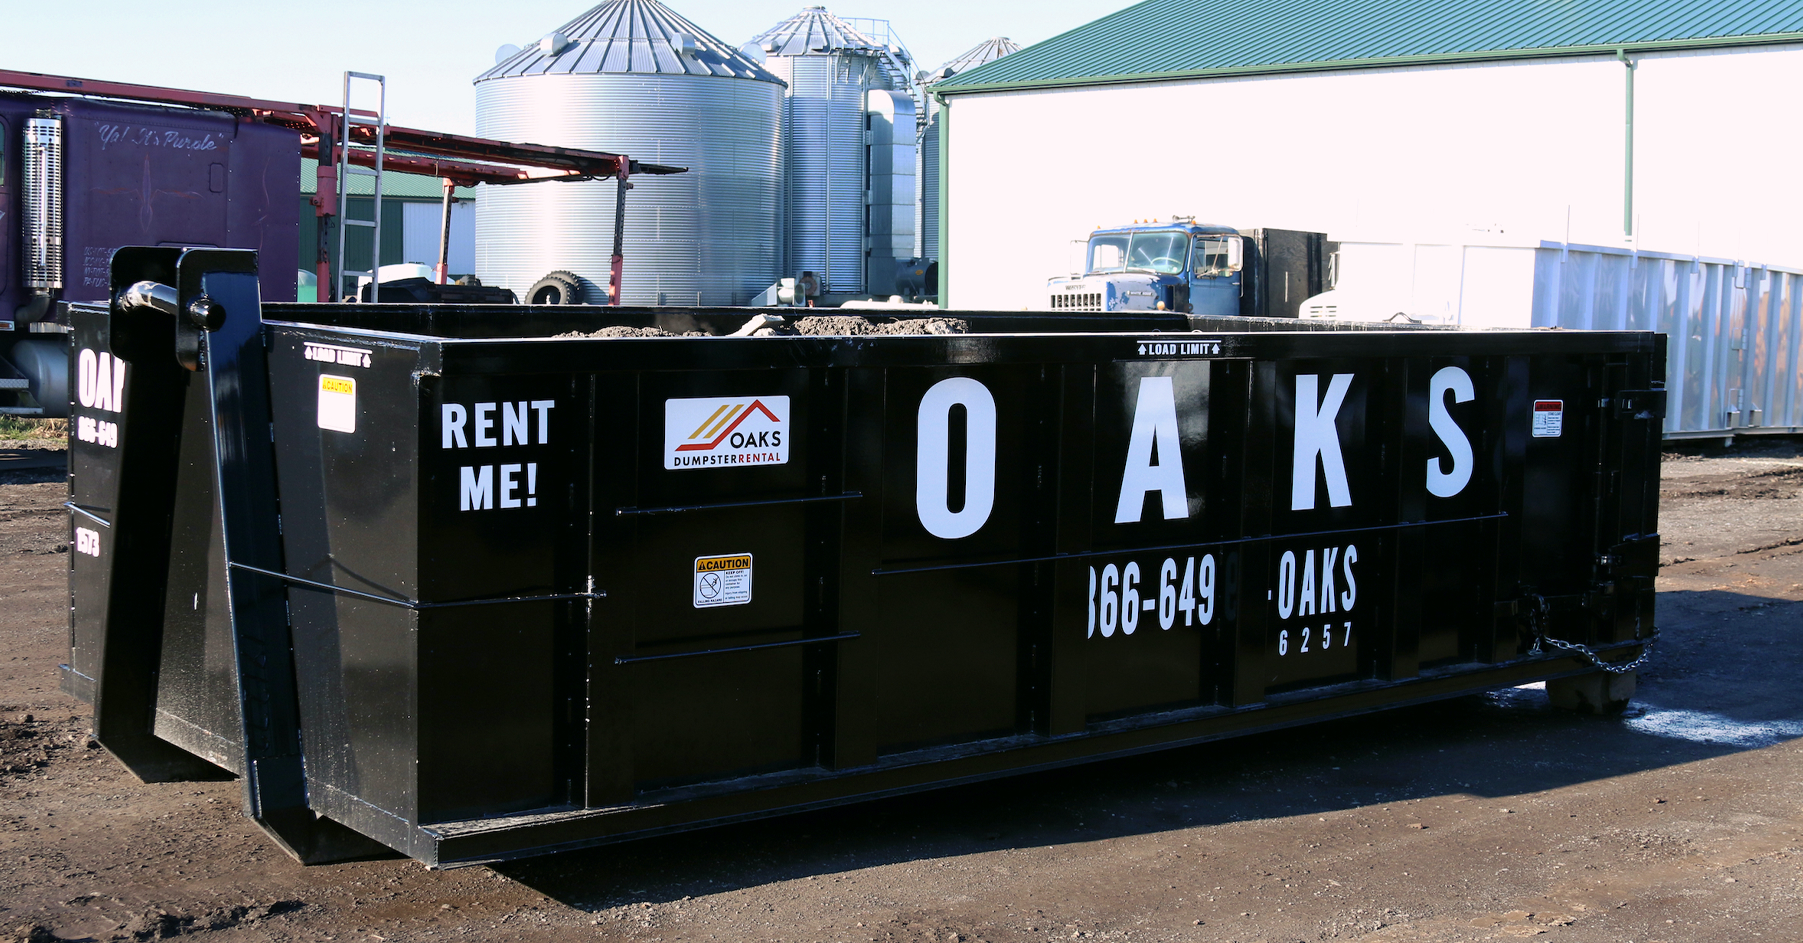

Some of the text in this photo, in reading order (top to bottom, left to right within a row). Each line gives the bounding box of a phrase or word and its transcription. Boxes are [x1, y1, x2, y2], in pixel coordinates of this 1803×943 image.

[1148, 343, 1210, 355] LOAD LIMIT
[326, 380, 353, 393] CAUTION
[441, 400, 555, 449] RENT
[730, 430, 781, 449] OAKS
[916, 366, 1476, 540] OAKS
[460, 463, 537, 511] ME!
[706, 558, 749, 570] CAUTION
[1268, 544, 1359, 620] OAKS
